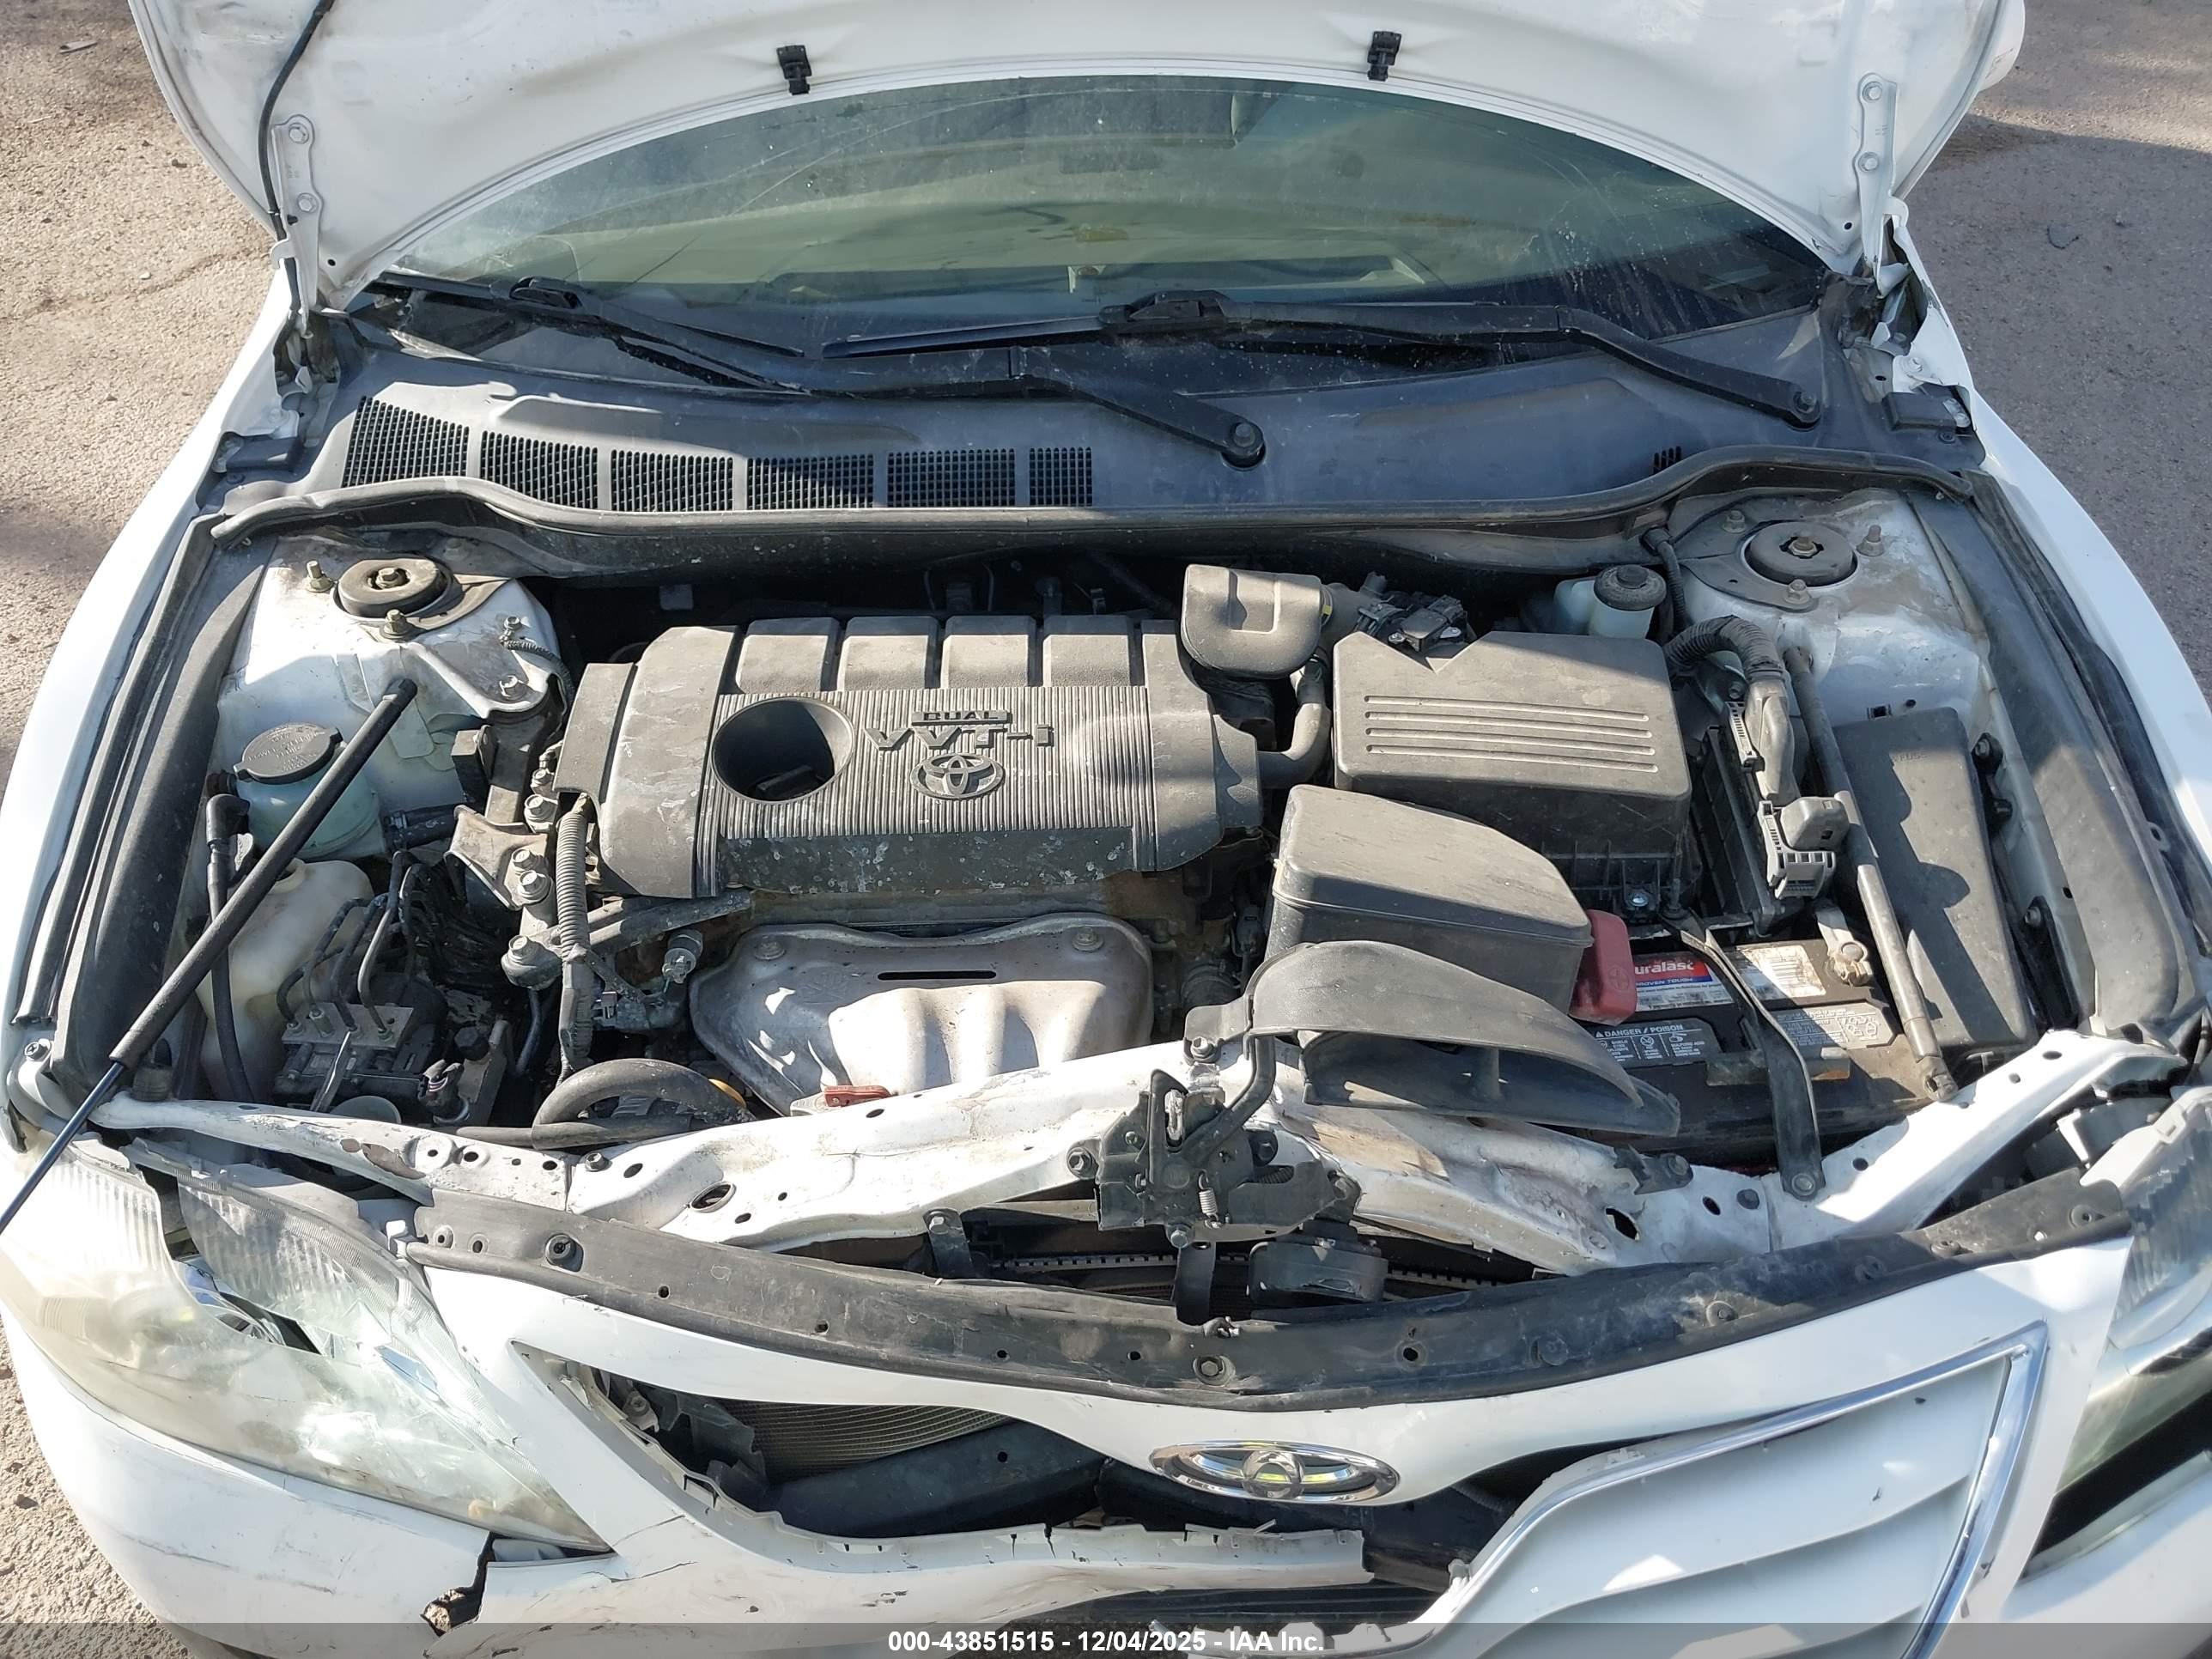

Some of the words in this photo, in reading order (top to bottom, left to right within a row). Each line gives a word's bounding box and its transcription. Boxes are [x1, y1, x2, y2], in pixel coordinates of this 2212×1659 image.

[921, 710, 1000, 721] DUAL
[1635, 960, 1695, 975] uralast
[1604, 1029, 1642, 1037] DANGER
[1650, 1024, 1684, 1033] POISON
